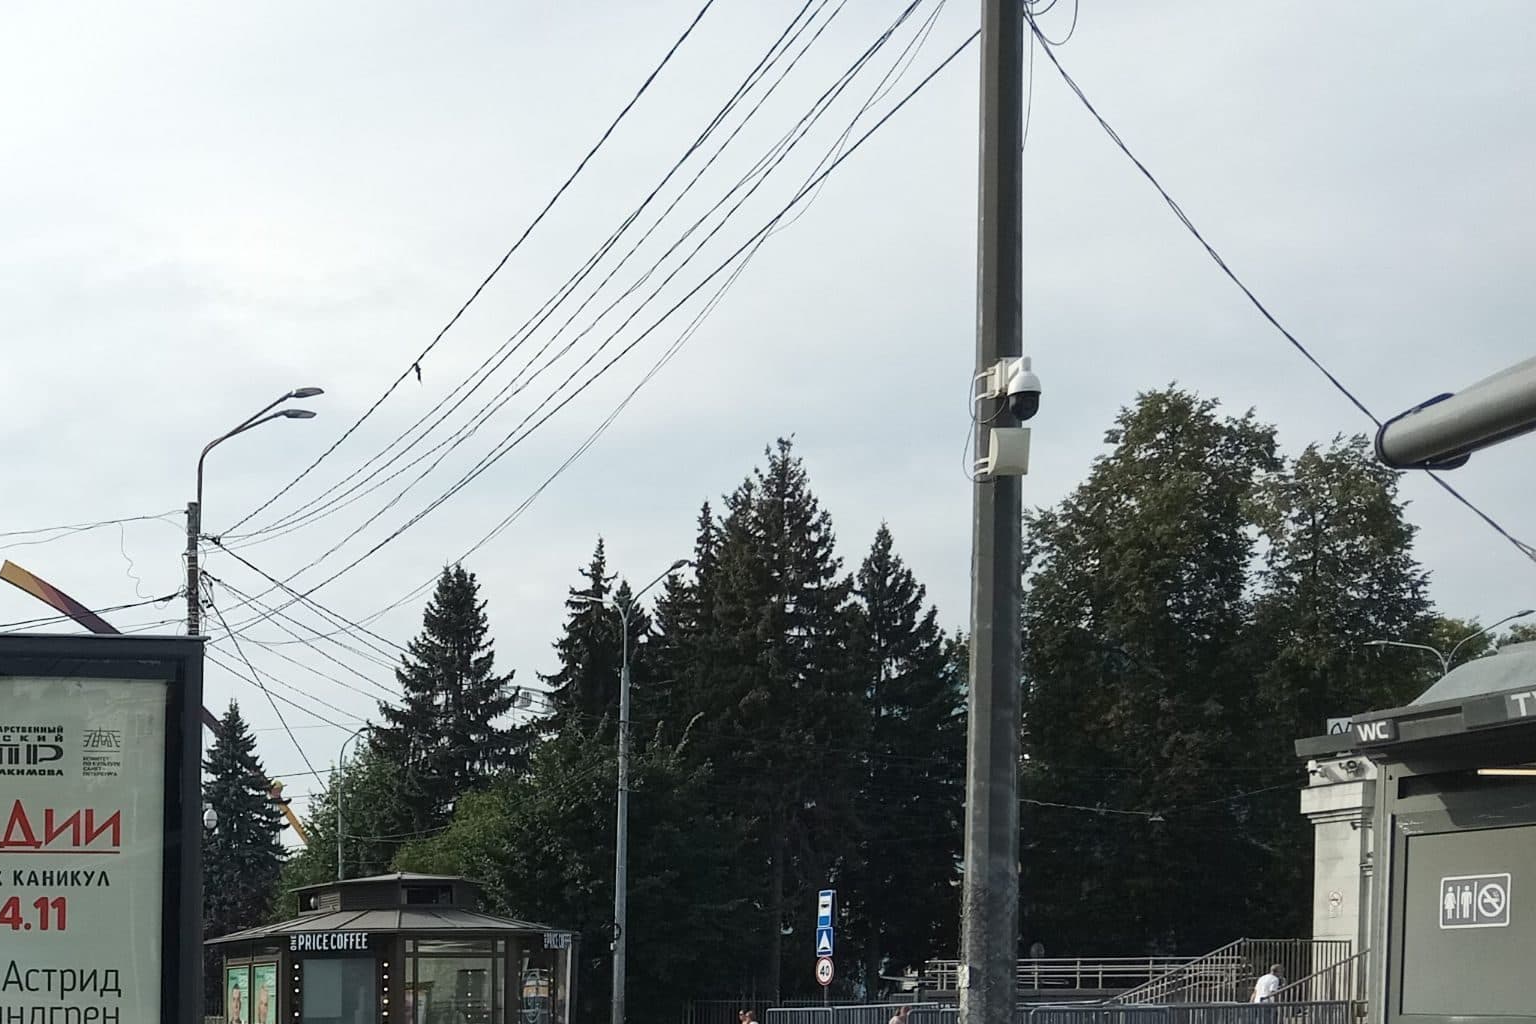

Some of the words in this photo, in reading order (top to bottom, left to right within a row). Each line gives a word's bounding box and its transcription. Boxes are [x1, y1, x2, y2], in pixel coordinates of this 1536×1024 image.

[1510, 691, 1536, 717] Т
[1357, 721, 1389, 742] WC
[13, 869, 111, 887] КАНИКУЛ
[298, 933, 329, 951] PRICE
[330, 932, 368, 950] COFFEE
[1, 960, 122, 1001] Астрид
[819, 965, 830, 977] 40
